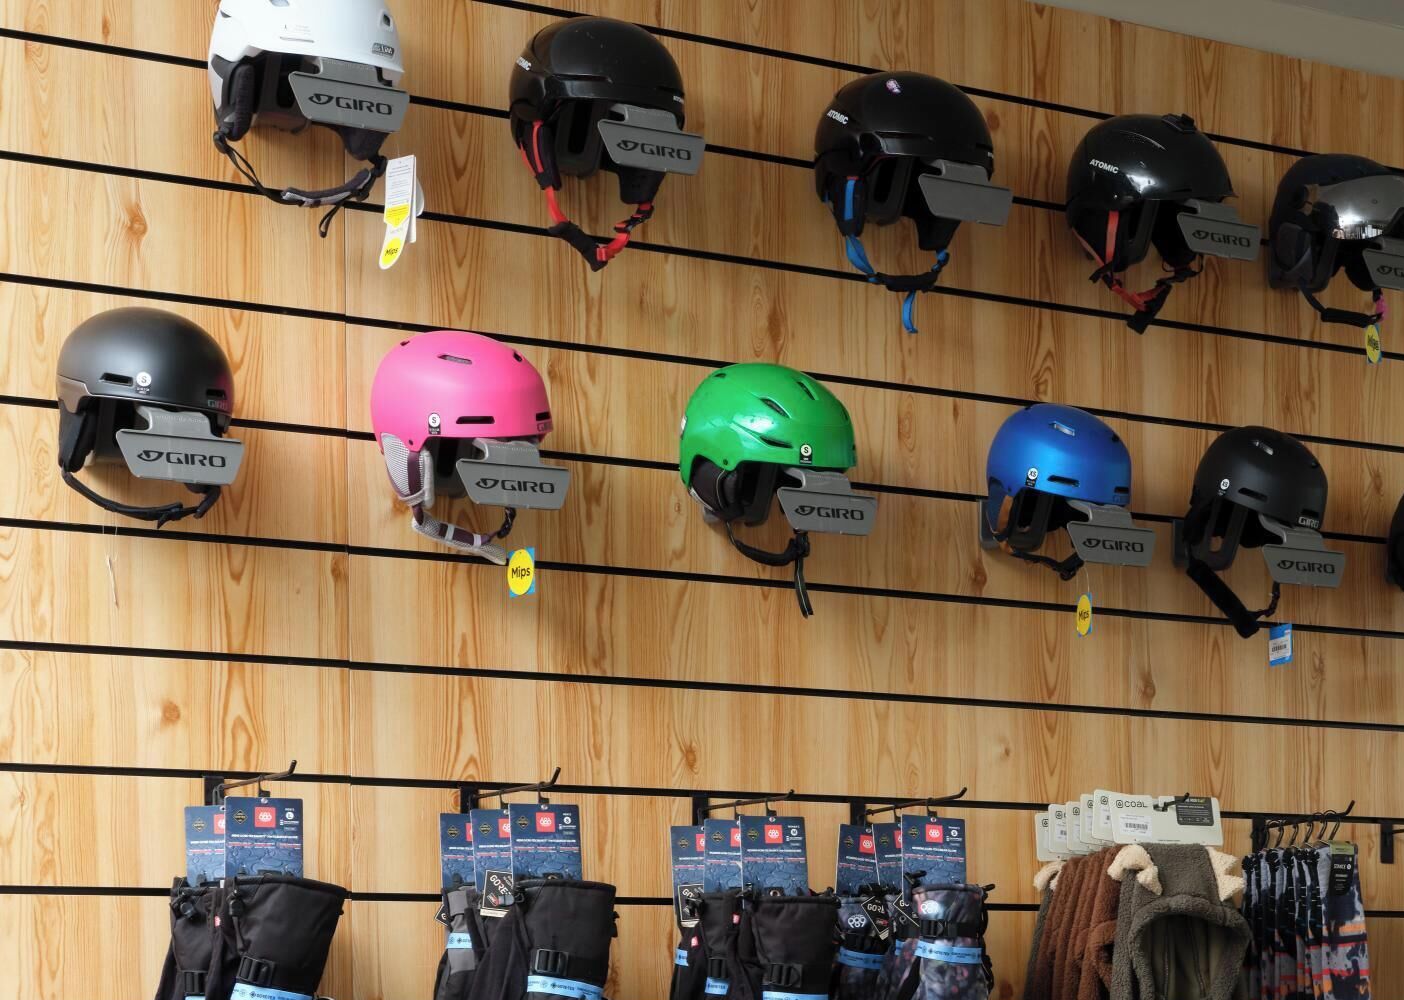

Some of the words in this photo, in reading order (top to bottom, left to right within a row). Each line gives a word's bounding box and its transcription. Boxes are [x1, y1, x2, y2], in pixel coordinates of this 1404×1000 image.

[335, 96, 392, 115] GIRO
[827, 109, 849, 125] ATOMIC
[641, 143, 692, 161] GIRO
[1089, 158, 1119, 174] ATOMIC
[1210, 232, 1251, 248] GIRO
[166, 451, 227, 468] GIRO
[501, 479, 556, 494] GIRO
[817, 506, 865, 521] GIRO
[1102, 538, 1145, 553] GIRO
[511, 566, 531, 579] Mips
[1295, 561, 1336, 574] GIRO
